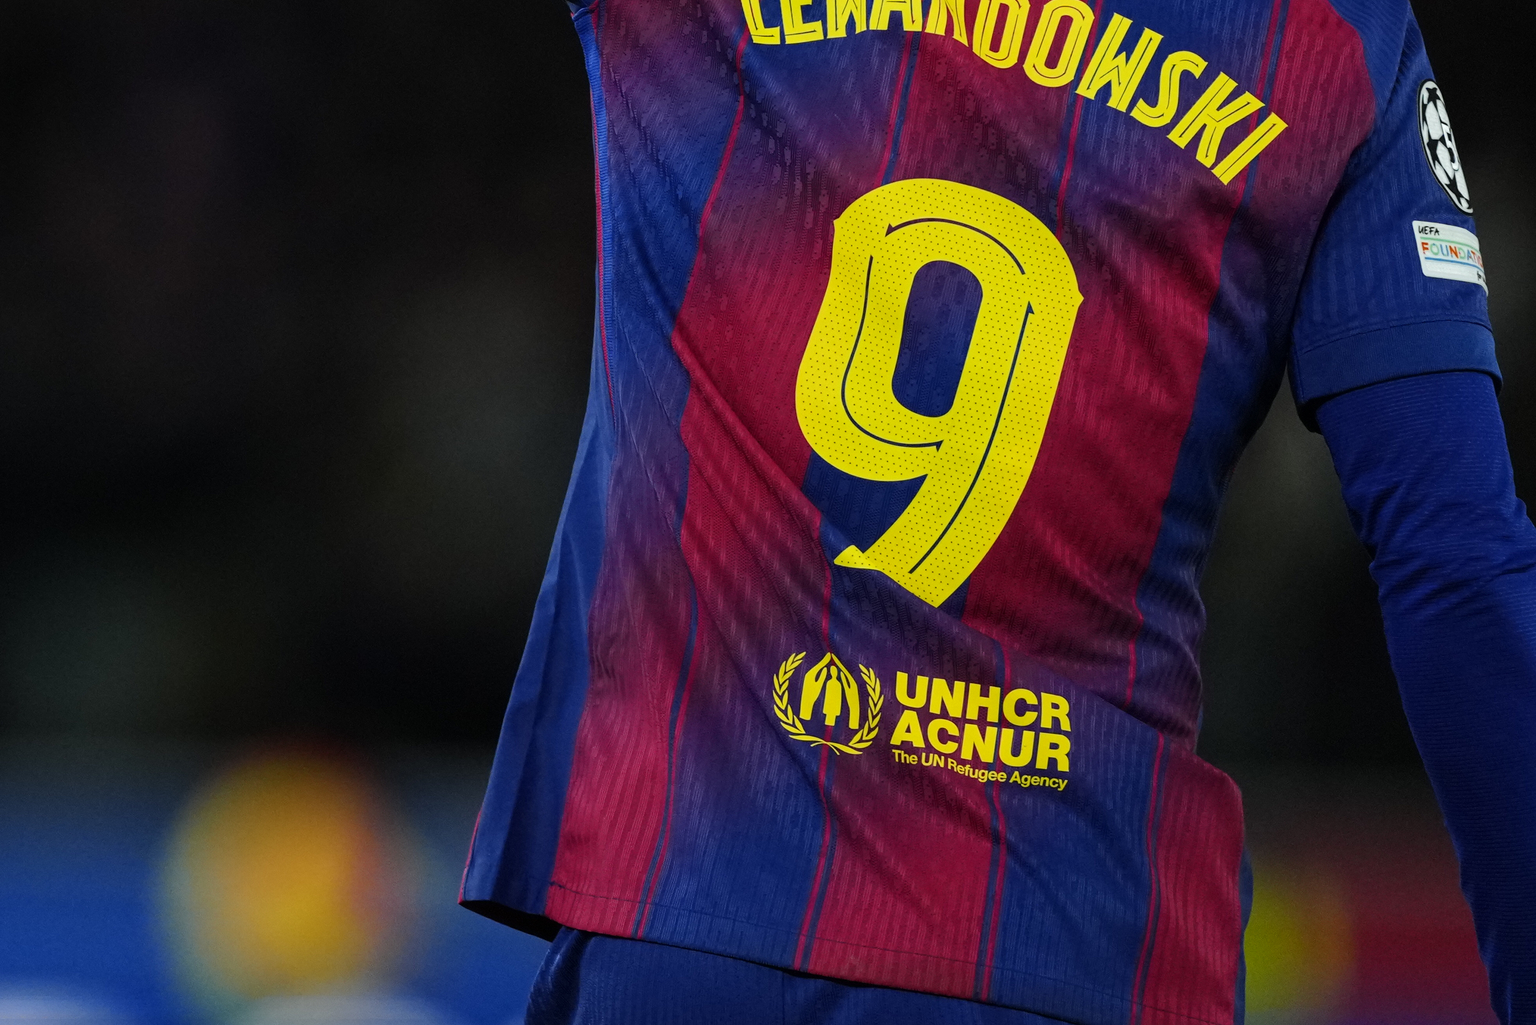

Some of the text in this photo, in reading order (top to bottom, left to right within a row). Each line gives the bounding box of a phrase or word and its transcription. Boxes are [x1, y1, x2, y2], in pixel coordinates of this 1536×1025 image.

[1418, 225, 1440, 236] UEFA
[795, 178, 1085, 609] 9
[895, 670, 1071, 732] UNHCR
[889, 709, 1072, 772] ACNUR
[891, 749, 1069, 792] The UN Refugee Agency
